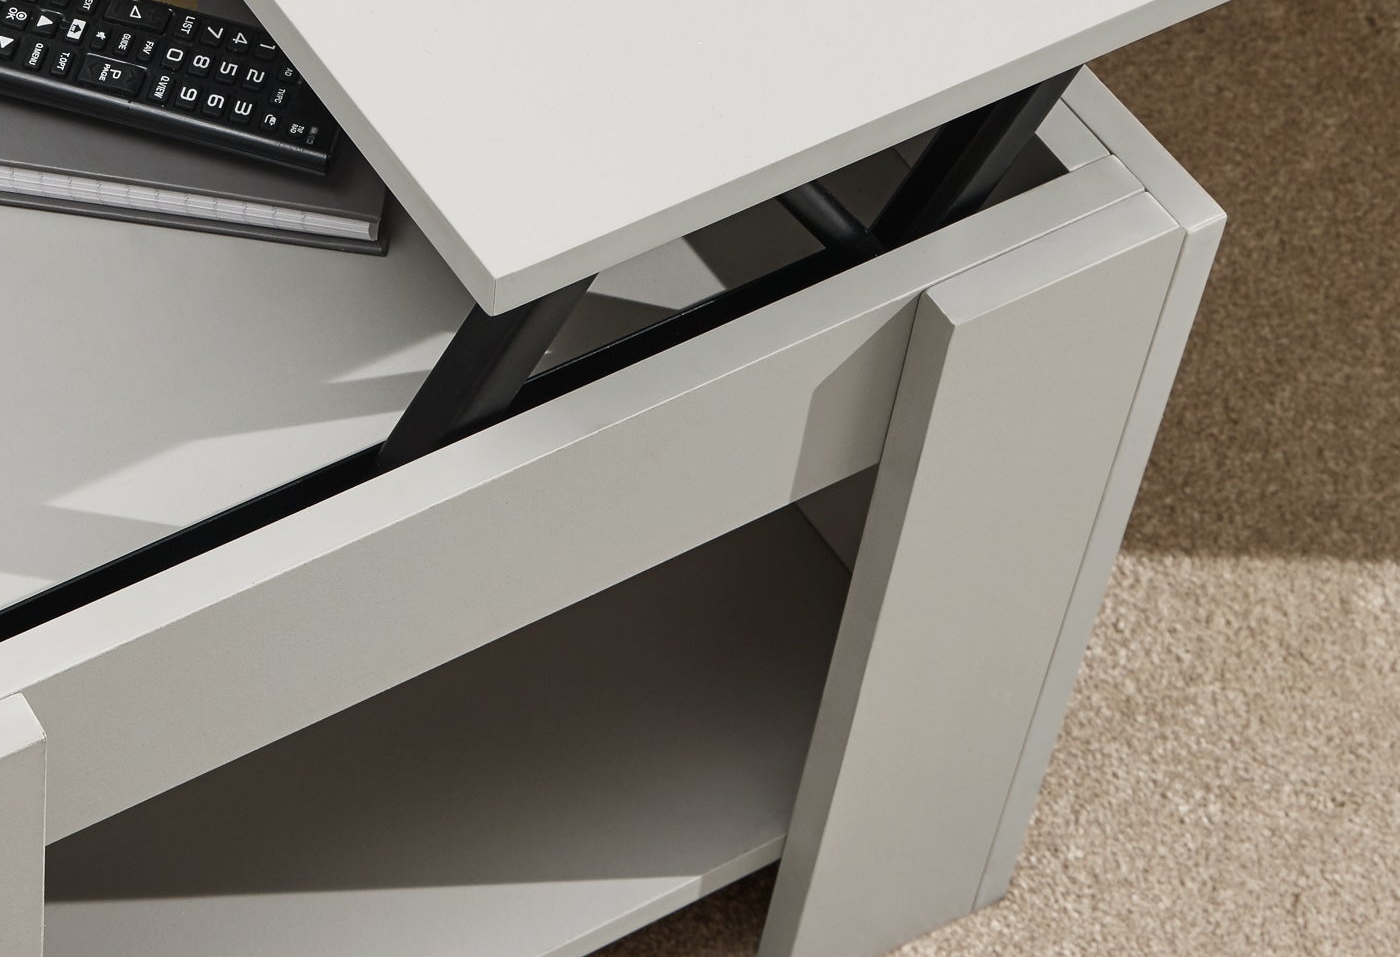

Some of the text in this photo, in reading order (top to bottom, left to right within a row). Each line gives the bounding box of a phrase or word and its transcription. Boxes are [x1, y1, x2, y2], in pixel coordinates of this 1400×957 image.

[6, 7, 18, 20] OK
[181, 15, 196, 34] LIST
[207, 26, 224, 39] 7
[232, 32, 248, 44] 4
[118, 33, 132, 51] GUIDE
[142, 40, 154, 55] FAV
[28, 42, 44, 66] Q.MENU
[56, 52, 70, 70] T.OPT
[166, 48, 184, 62] 0
[192, 55, 210, 68] 8
[99, 63, 111, 82] PAGE
[110, 68, 122, 79] P
[220, 62, 238, 76] 5
[246, 68, 265, 83] 2
[154, 75, 170, 98] Q.VIEW
[180, 86, 198, 102] 9
[207, 94, 225, 109] 6
[234, 100, 252, 116] 3
